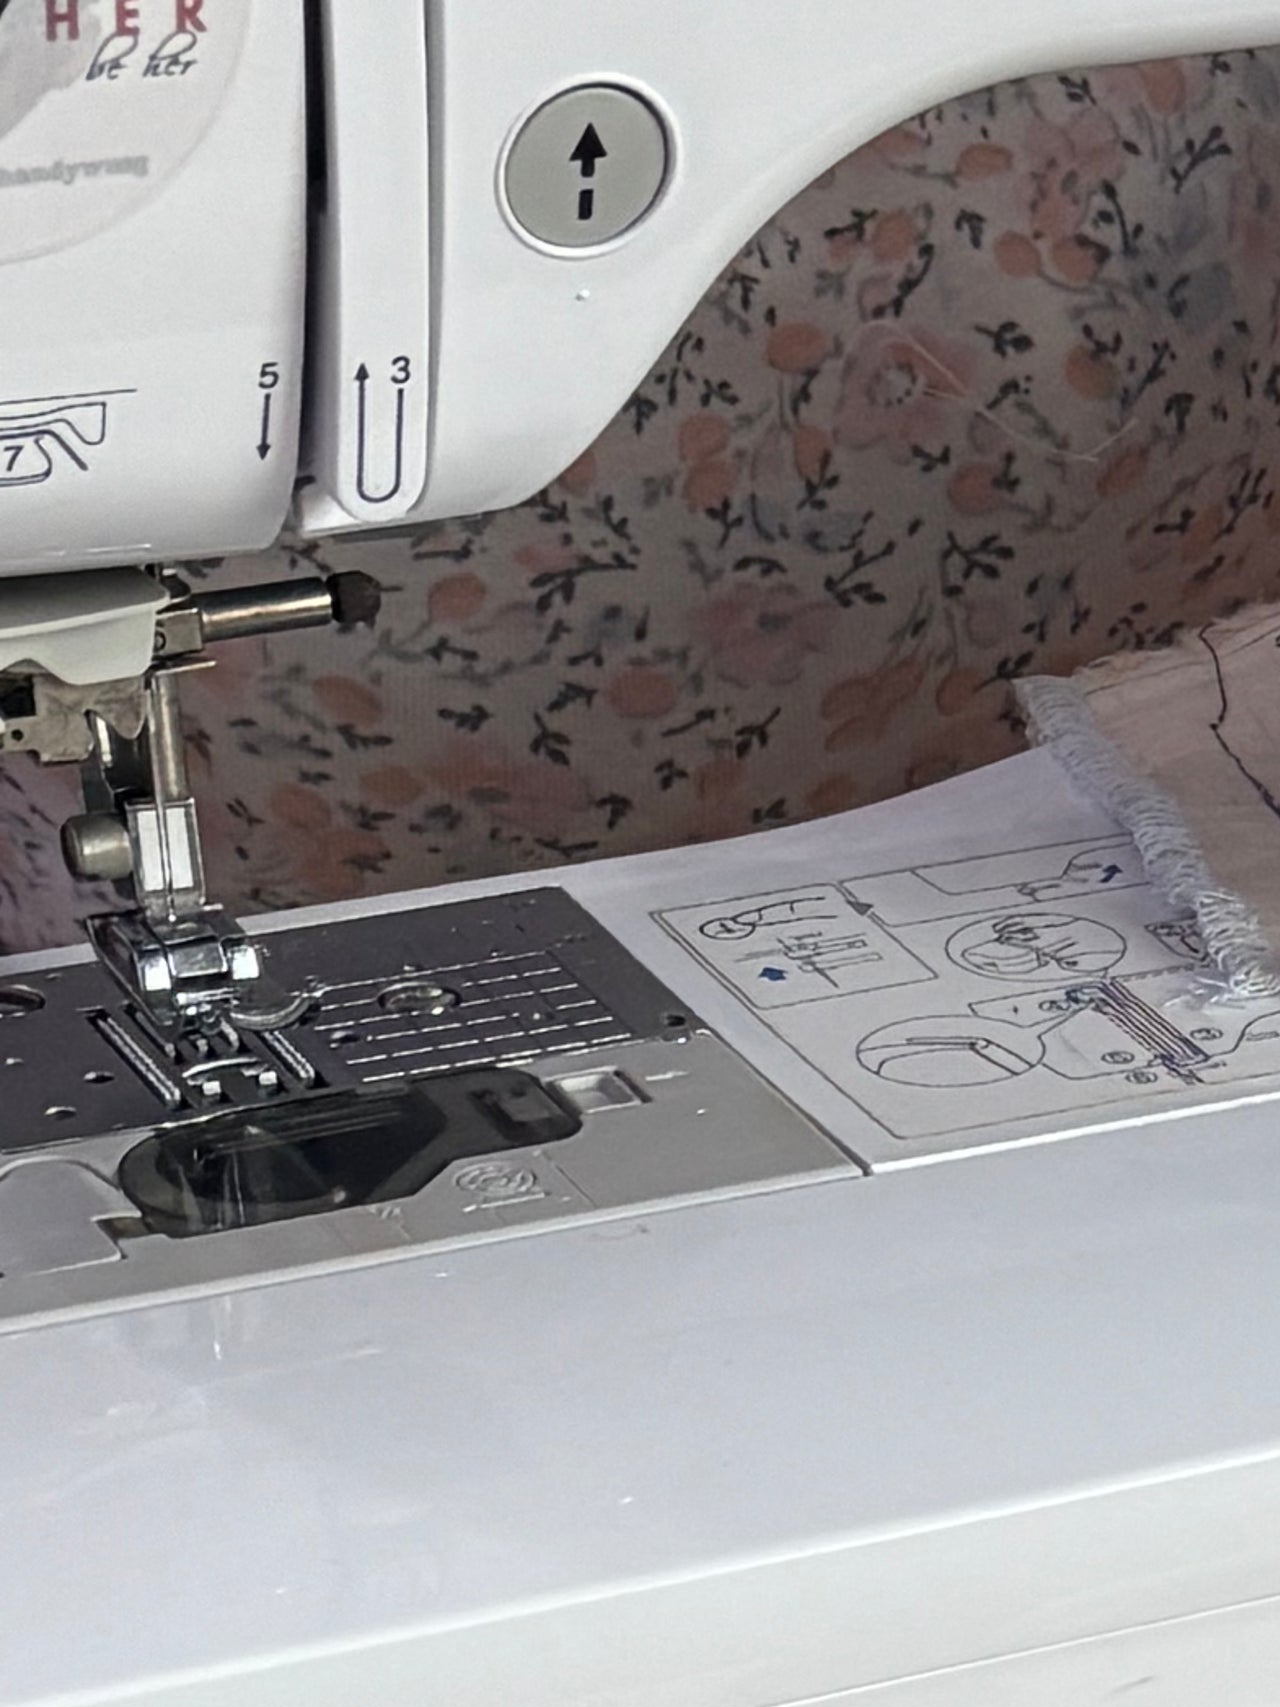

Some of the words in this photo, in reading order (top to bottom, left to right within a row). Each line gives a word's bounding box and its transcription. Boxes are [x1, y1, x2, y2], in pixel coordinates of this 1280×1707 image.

[258, 362, 280, 389] 5
[390, 355, 411, 384] 3
[3, 445, 24, 472] 7
